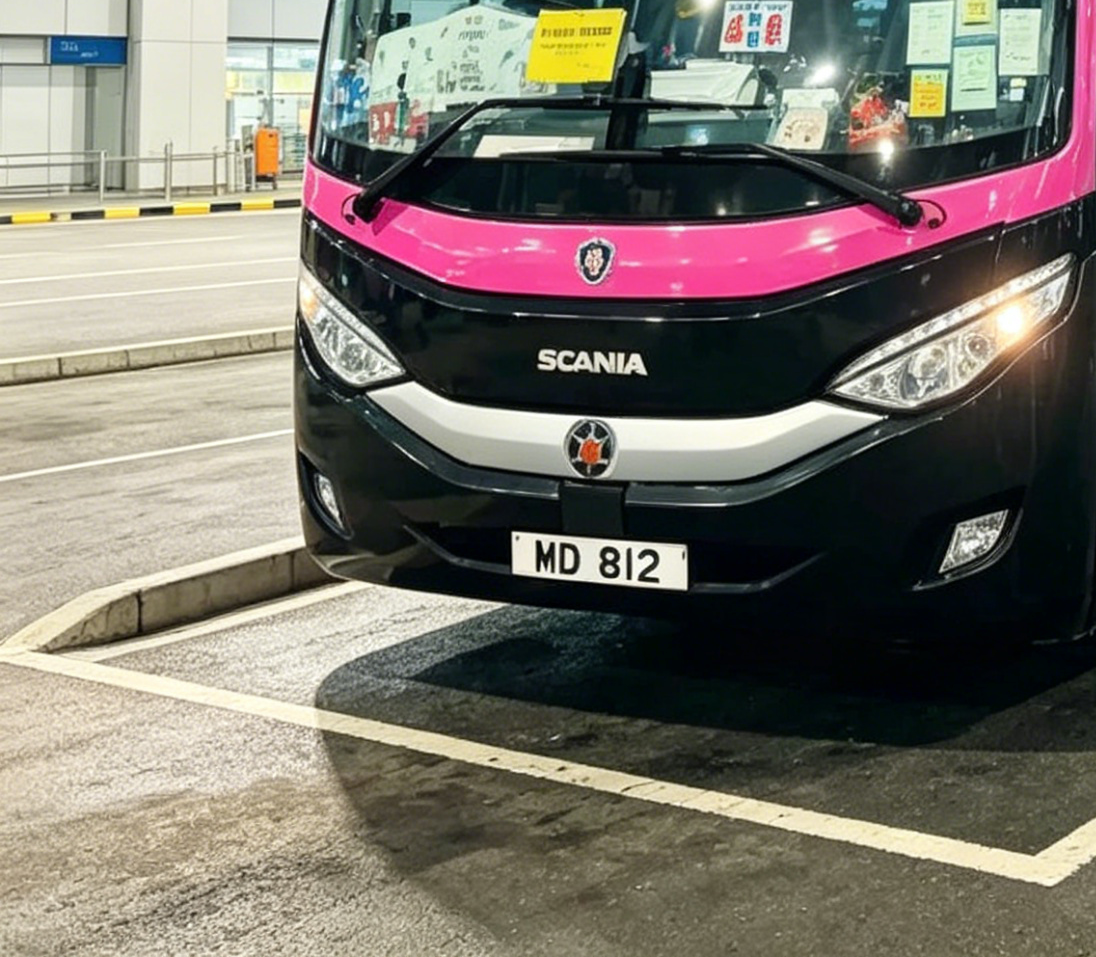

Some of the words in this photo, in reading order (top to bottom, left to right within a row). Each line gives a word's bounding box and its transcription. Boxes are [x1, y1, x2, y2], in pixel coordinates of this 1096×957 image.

[537, 348, 648, 377] SCANIA
[535, 539, 581, 576] MD
[599, 546, 660, 584] 812
